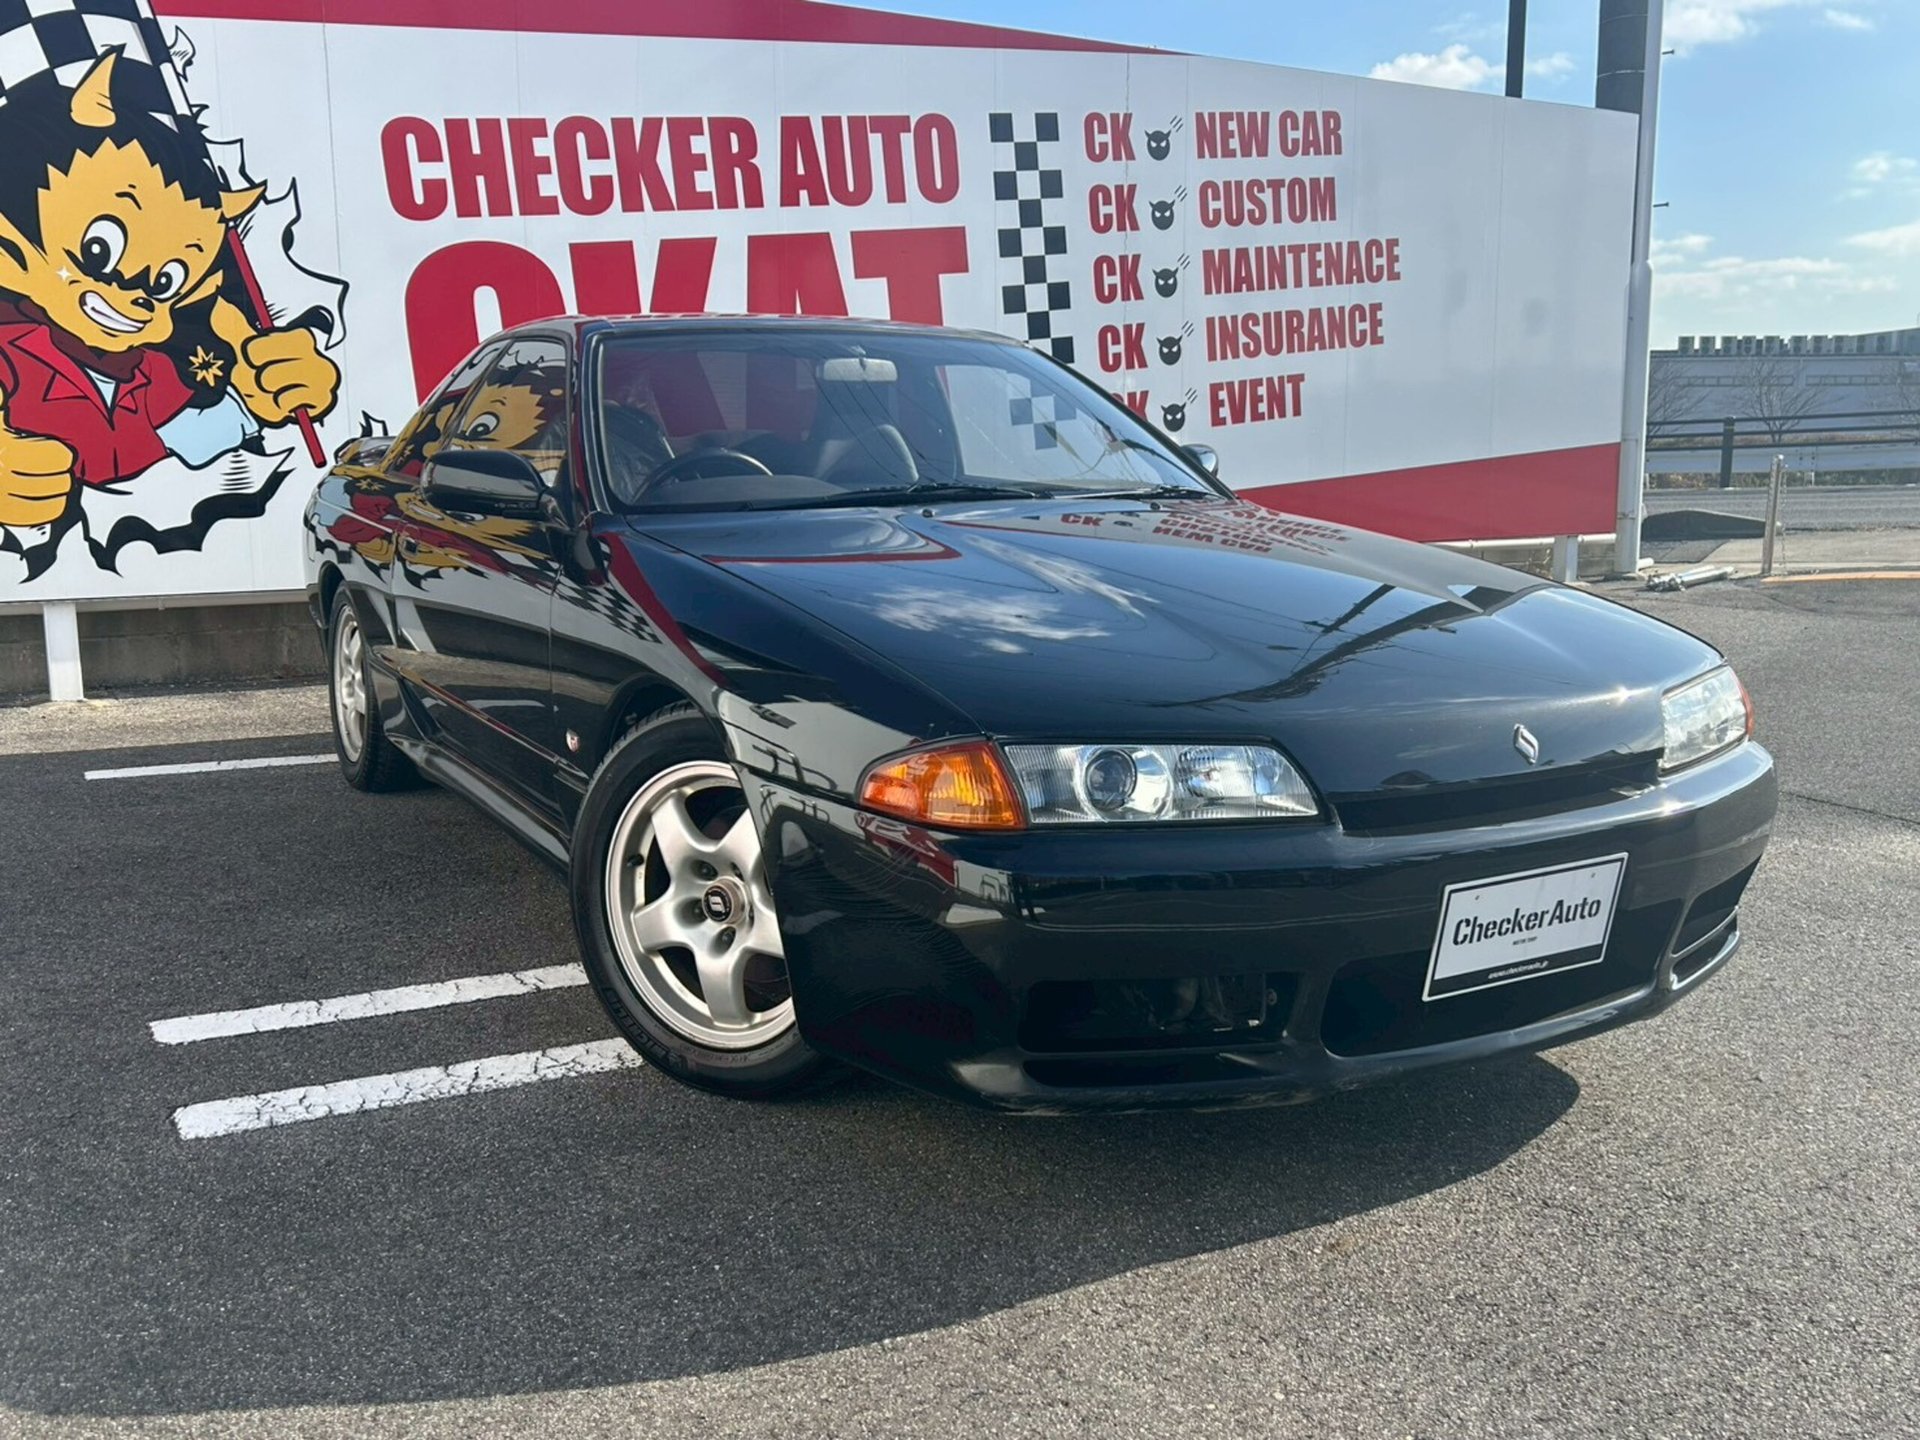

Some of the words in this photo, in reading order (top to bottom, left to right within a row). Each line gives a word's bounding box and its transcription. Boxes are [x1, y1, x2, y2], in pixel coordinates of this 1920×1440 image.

[1083, 112, 1136, 162] CK
[1195, 111, 1270, 159] NEW
[1278, 110, 1342, 157] CAR
[381, 116, 764, 221] CHECKER
[779, 113, 959, 207] AUTO
[1088, 184, 1140, 234] CK
[1198, 177, 1337, 228] CUSTOM
[1093, 253, 1144, 304] CK
[1202, 238, 1401, 295] MAINTENACE
[1097, 322, 1148, 373] CK
[1205, 302, 1384, 362] INSURANCE
[1111, 389, 1149, 422] K
[1209, 373, 1305, 427] EVENT
